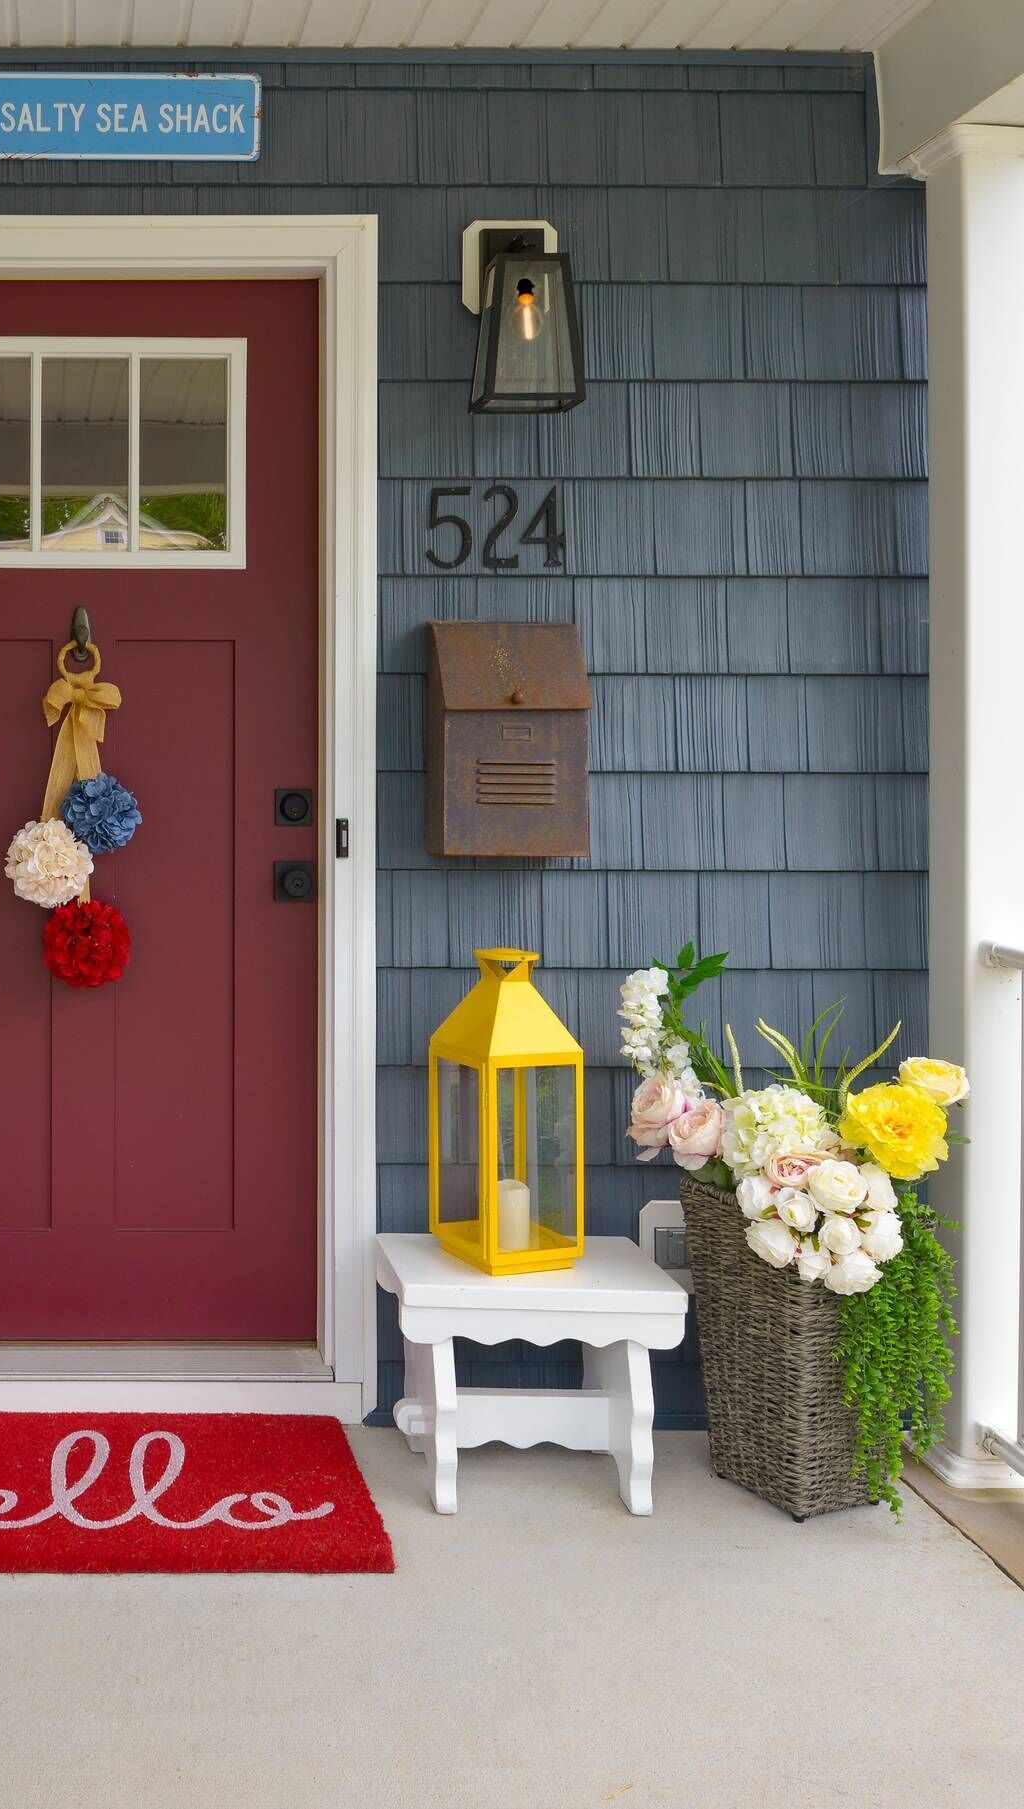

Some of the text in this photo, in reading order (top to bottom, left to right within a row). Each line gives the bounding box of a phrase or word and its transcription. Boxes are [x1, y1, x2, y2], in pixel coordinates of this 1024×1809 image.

[0, 102, 86, 133] SALTY
[95, 103, 148, 133] SEA
[158, 103, 246, 134] SHACK
[425, 484, 567, 569] 524
